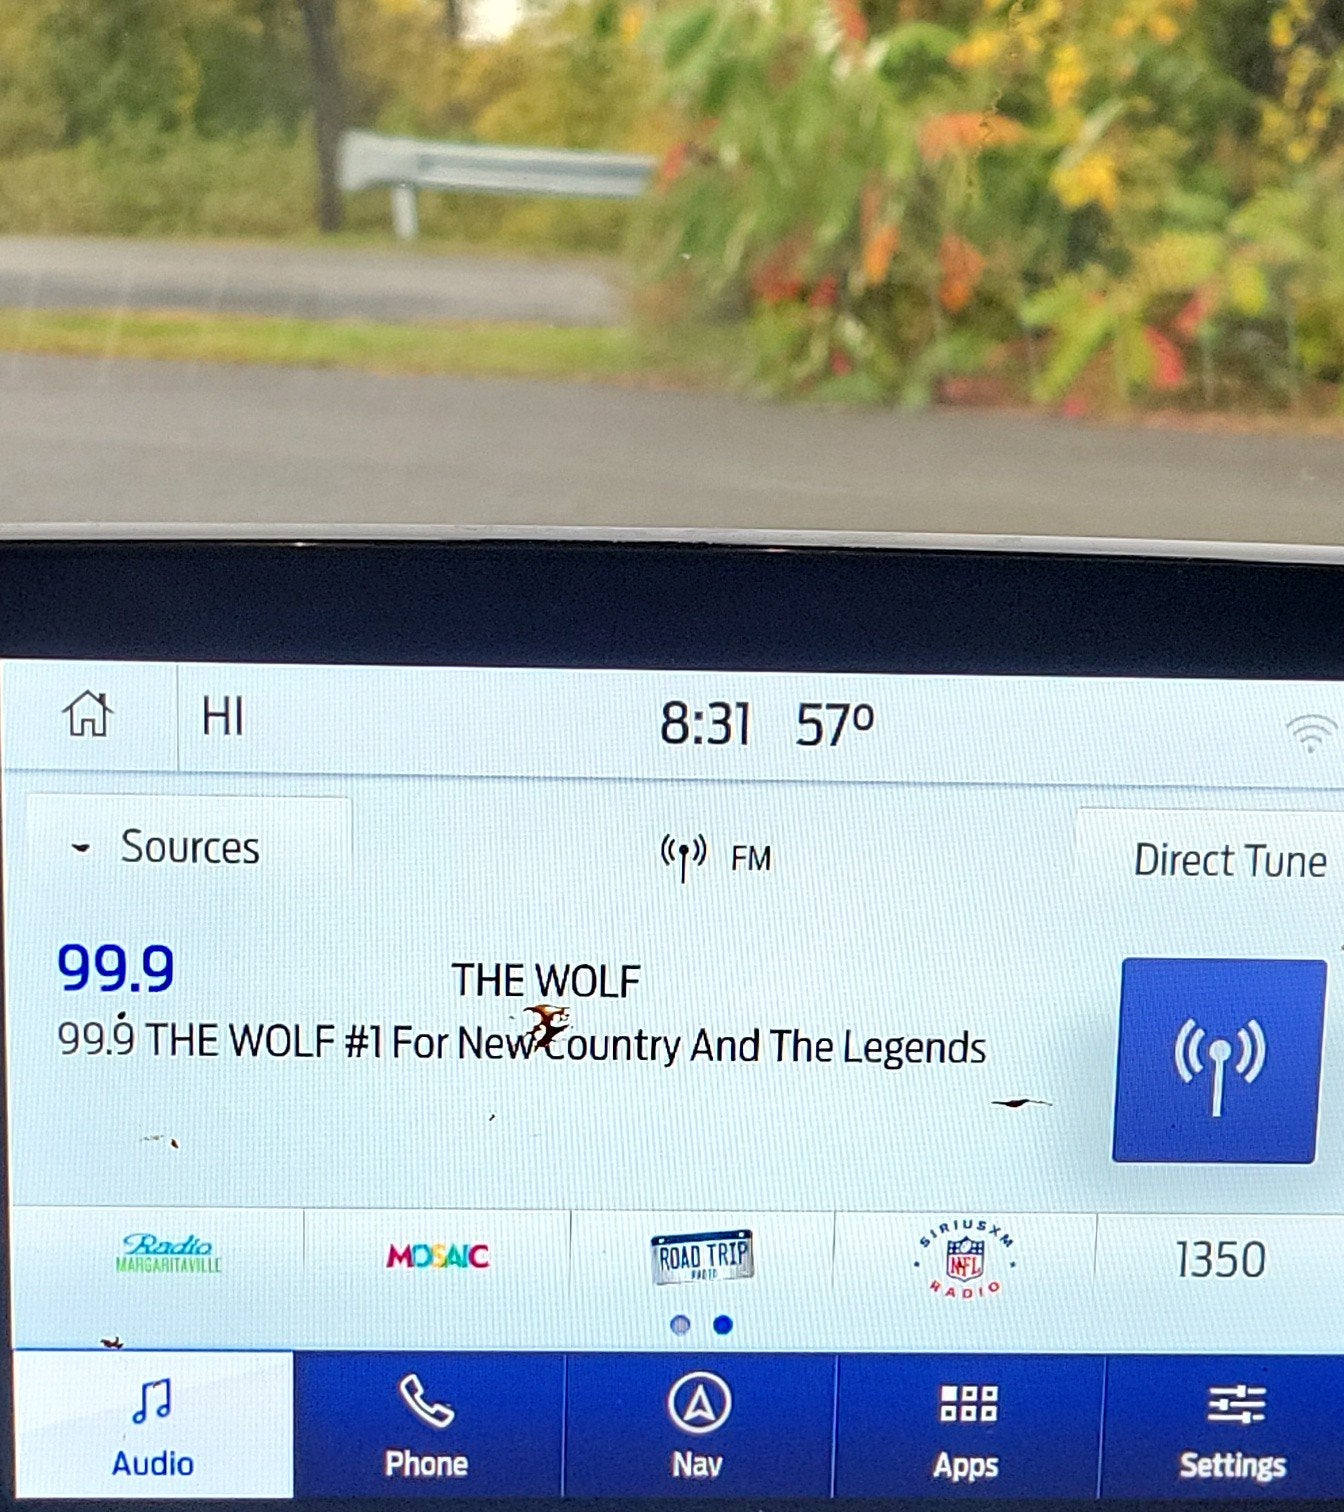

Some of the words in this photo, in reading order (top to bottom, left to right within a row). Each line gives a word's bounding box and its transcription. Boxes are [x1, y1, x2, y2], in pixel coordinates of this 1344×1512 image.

[202, 694, 243, 737] HI
[660, 700, 750, 746] 8:31
[121, 828, 261, 865] Sources
[731, 845, 772, 872] FM
[1134, 842, 1236, 878] Direct
[1244, 843, 1328, 879] Tune
[57, 942, 175, 994] 99.9
[451, 962, 525, 998] THE
[535, 963, 642, 999] WOLF
[58, 1021, 134, 1056] 99.9
[145, 1022, 219, 1057] THE
[228, 1023, 336, 1059] WOLF
[345, 1024, 382, 1059] #1
[393, 1025, 450, 1060] For
[458, 1025, 536, 1060] New
[689, 1027, 760, 1062] And
[769, 1028, 834, 1063] The
[843, 1029, 987, 1070] Legends
[123, 1233, 212, 1255] Radio
[919, 1219, 1014, 1248] SIRIUSXM
[116, 1256, 222, 1274] MARGARITAVILLE
[385, 1243, 490, 1269] MOSAIC
[660, 1245, 701, 1271] ROAD
[707, 1240, 749, 1267] TRIP
[1175, 1239, 1267, 1279] 1350
[929, 1280, 1001, 1299] RADIO
[111, 1449, 195, 1477] Audio
[384, 1448, 470, 1478] Phone
[672, 1451, 724, 1478] Nav
[932, 1451, 1000, 1483] Apps
[1179, 1451, 1288, 1483] Settings
